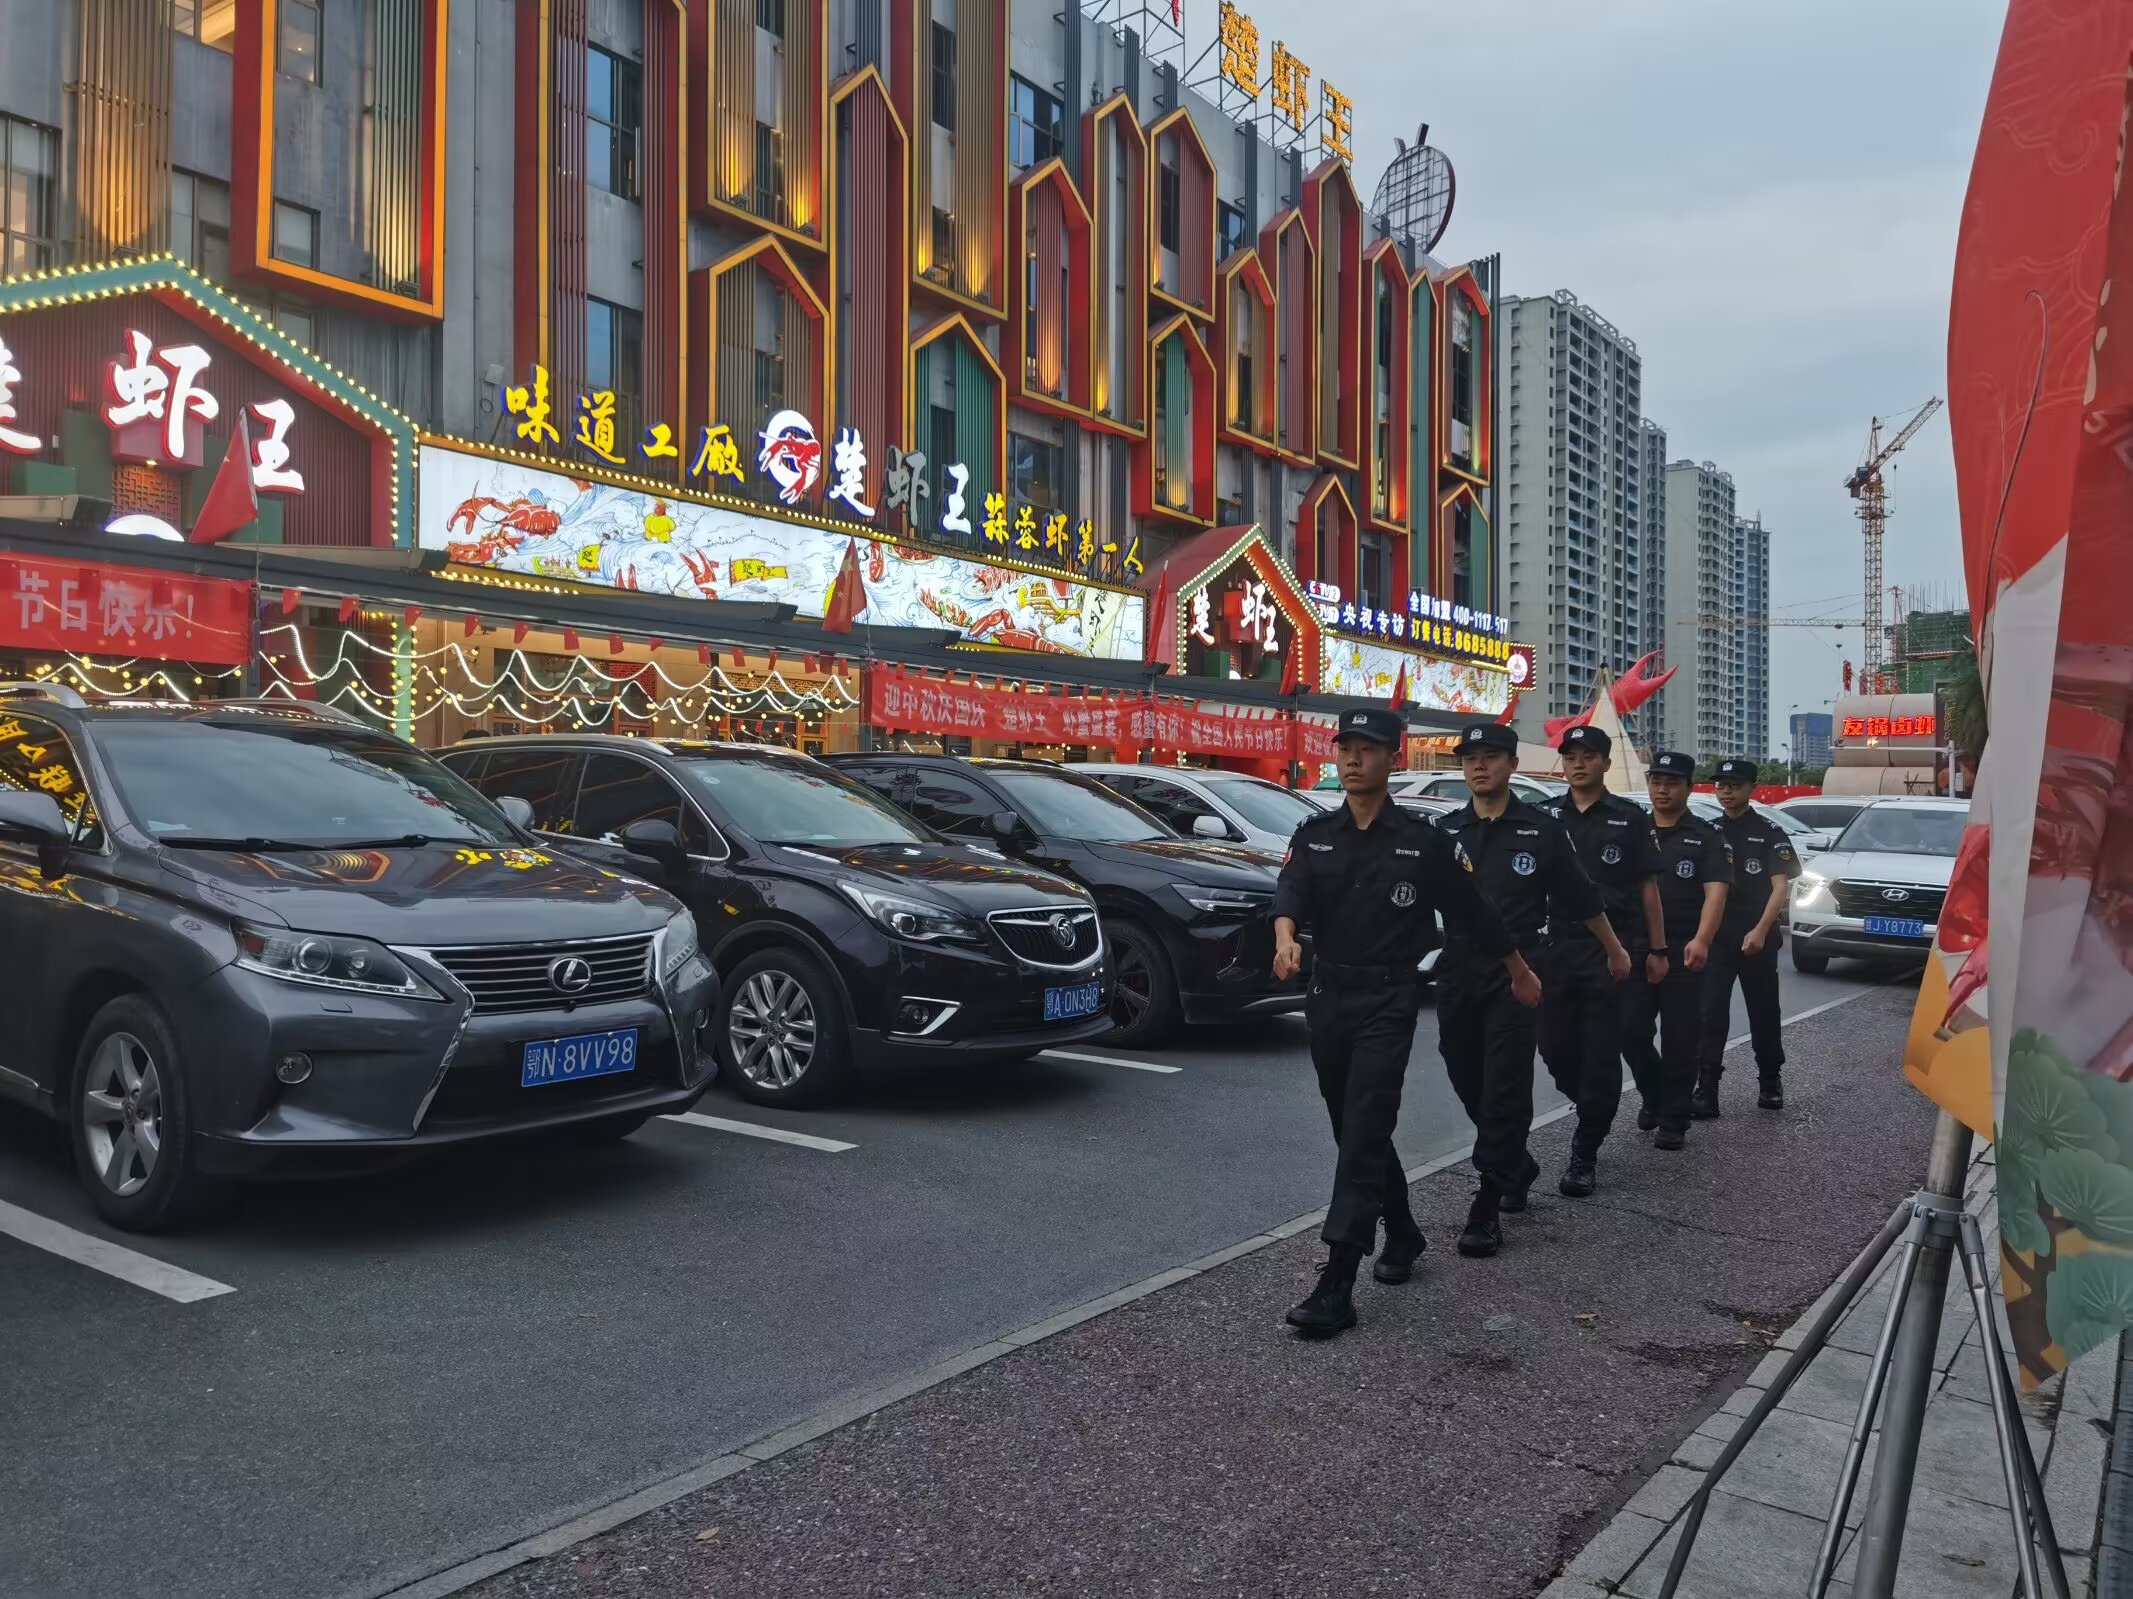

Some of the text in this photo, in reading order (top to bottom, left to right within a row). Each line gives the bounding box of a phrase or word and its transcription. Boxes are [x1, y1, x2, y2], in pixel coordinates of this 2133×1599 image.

[1221, 2, 1354, 162] 楚虾王
[829, 427, 972, 535] 楚虾王
[982, 492, 1143, 574] 蒜蓉虾第一人
[1343, 601, 1405, 637] 央视专访
[1410, 591, 1450, 622] 全国加盟
